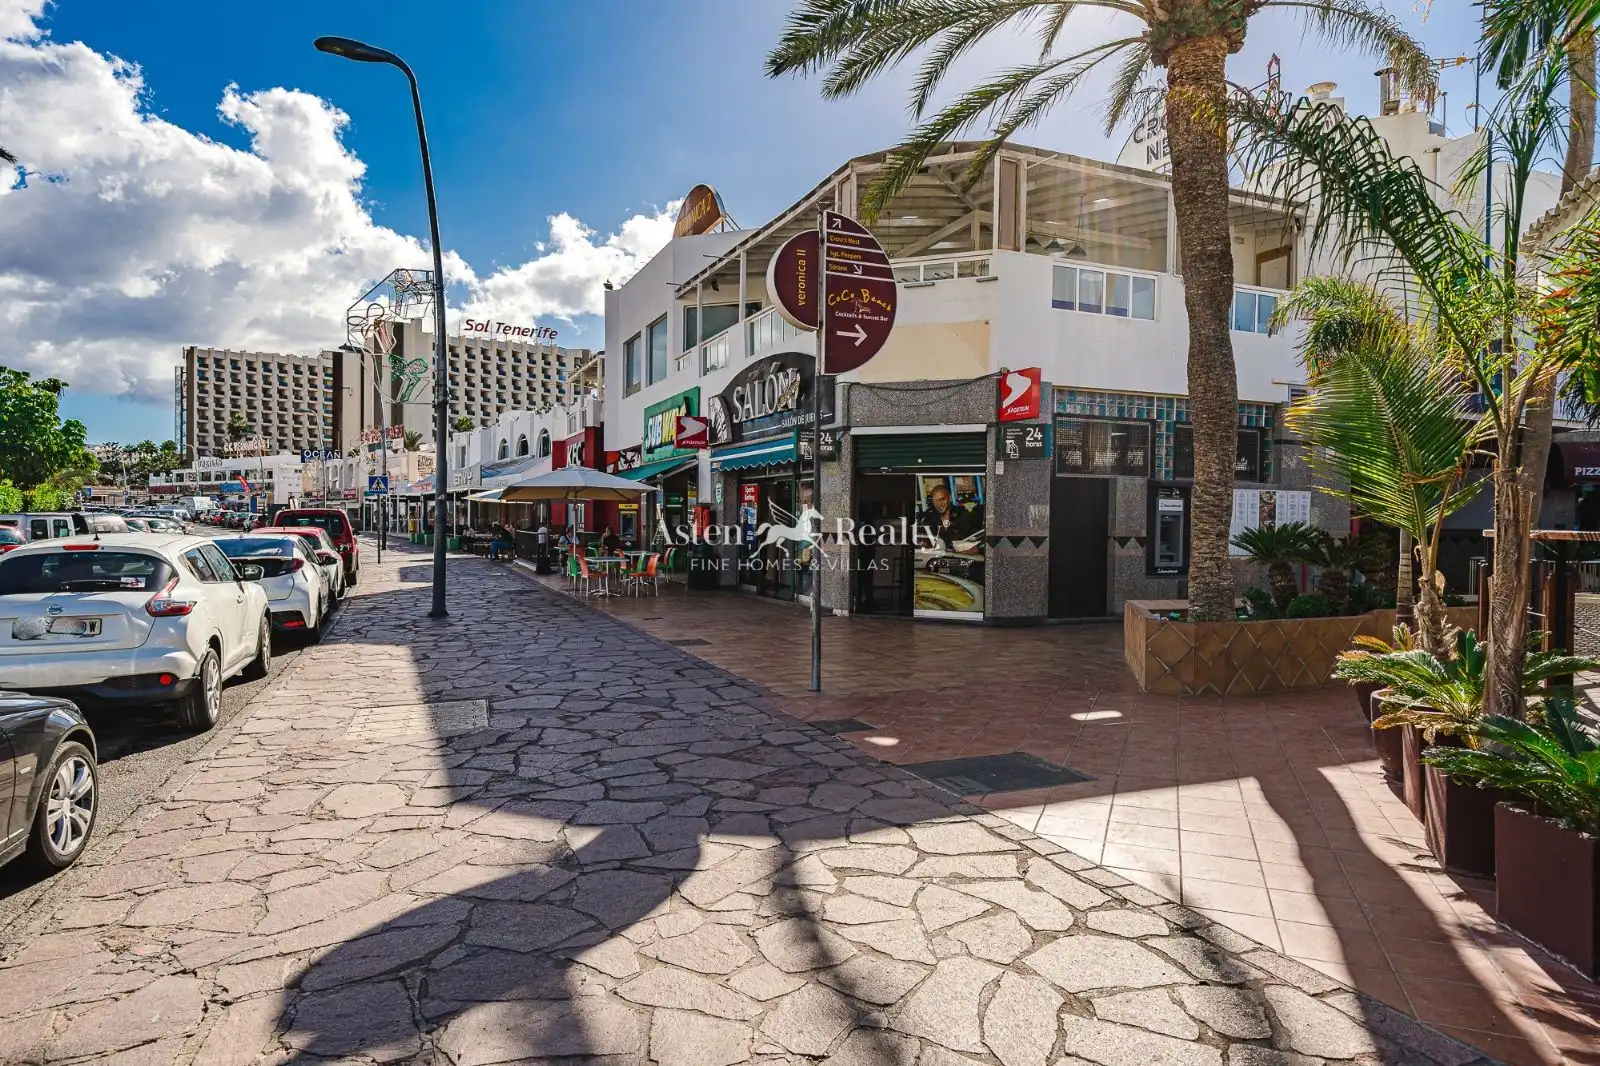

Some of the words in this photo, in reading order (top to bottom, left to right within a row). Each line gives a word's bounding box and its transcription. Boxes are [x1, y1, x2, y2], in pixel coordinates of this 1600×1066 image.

[1133, 115, 1168, 143] CR
[797, 259, 806, 306] veronica
[860, 289, 892, 311] Beach
[835, 311, 857, 319] Cocktails
[464, 319, 490, 332] Sol
[495, 321, 558, 339] Tenerife
[781, 416, 797, 428] SALÓN
[798, 414, 805, 424] DE
[820, 432, 833, 444] 24
[1025, 427, 1043, 440] 24
[304, 449, 341, 459] OCEAN
